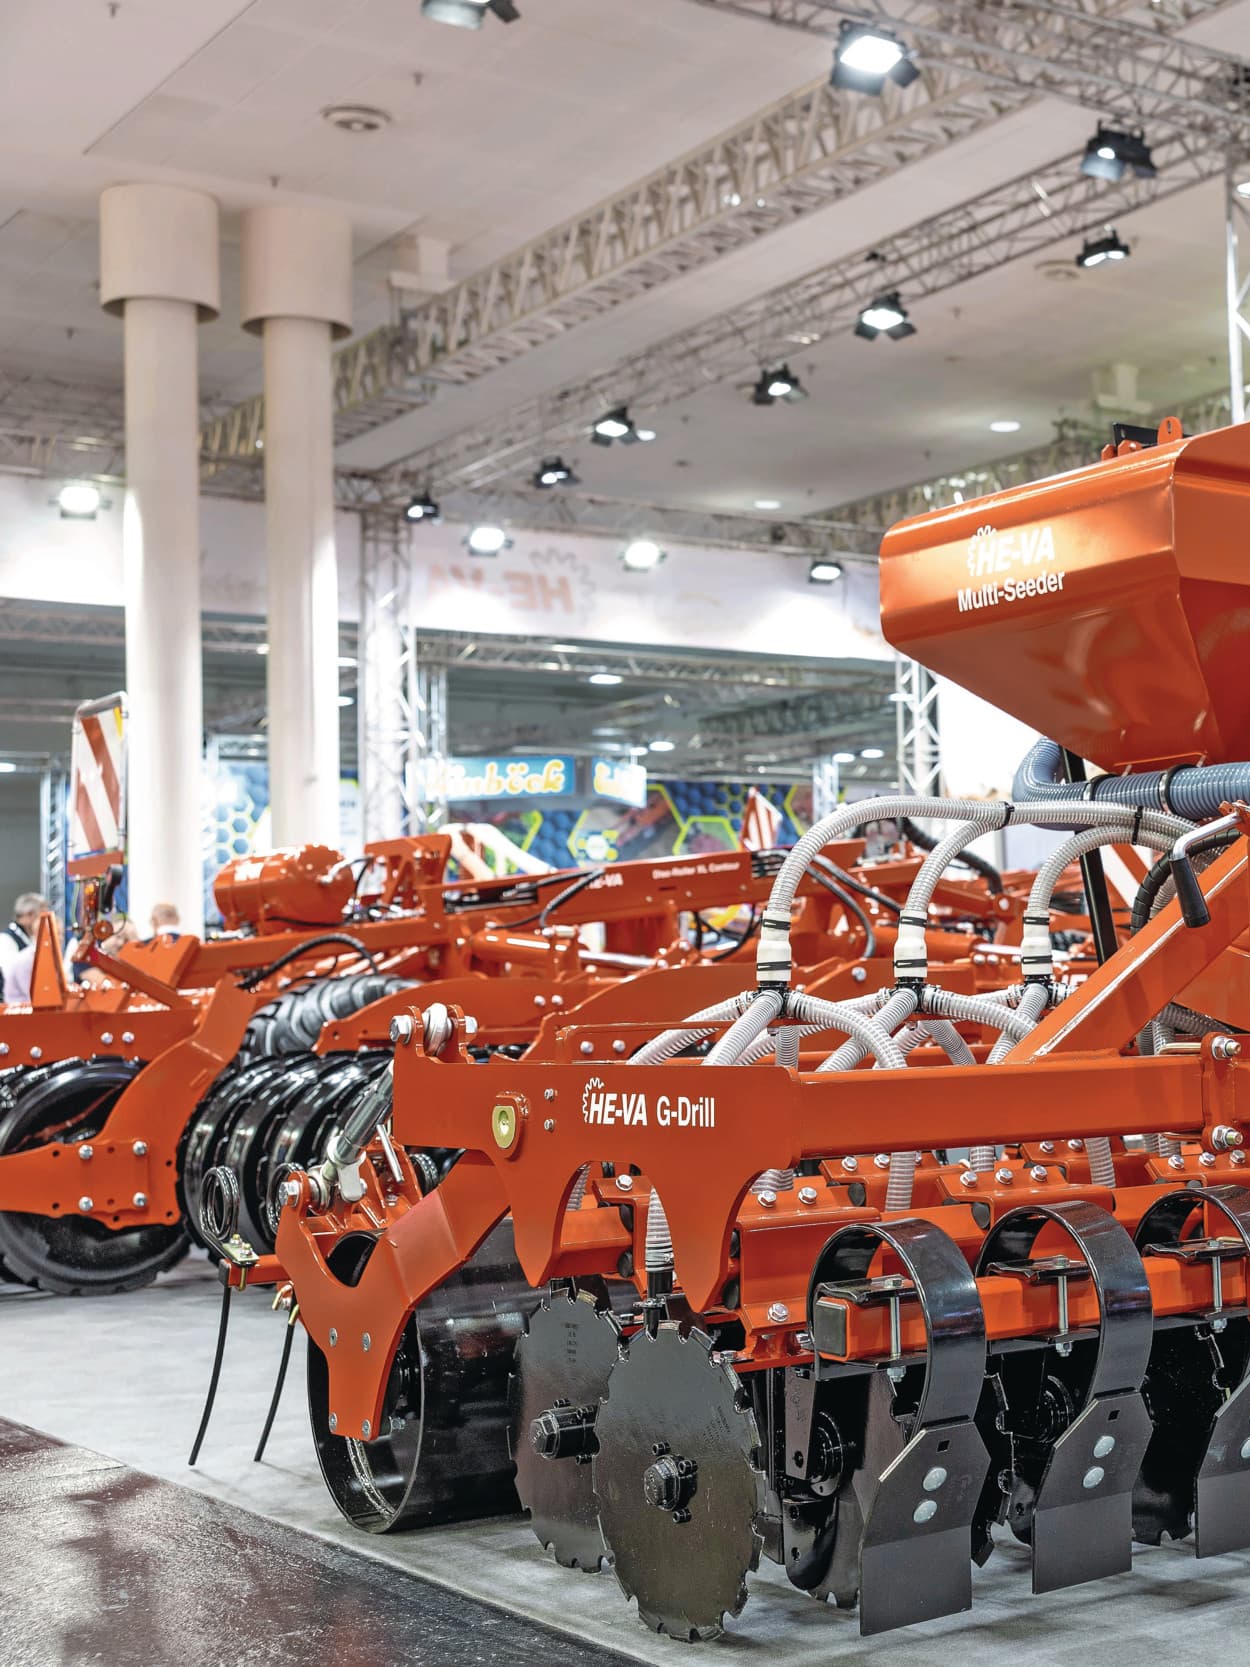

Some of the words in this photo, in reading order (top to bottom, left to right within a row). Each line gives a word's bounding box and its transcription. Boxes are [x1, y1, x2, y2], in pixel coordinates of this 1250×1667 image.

[975, 526, 1056, 577] HE-VA
[957, 570, 1066, 613] Multi-Seeder
[588, 1092, 648, 1127] HE-VA
[656, 1095, 716, 1128] G-Drill
